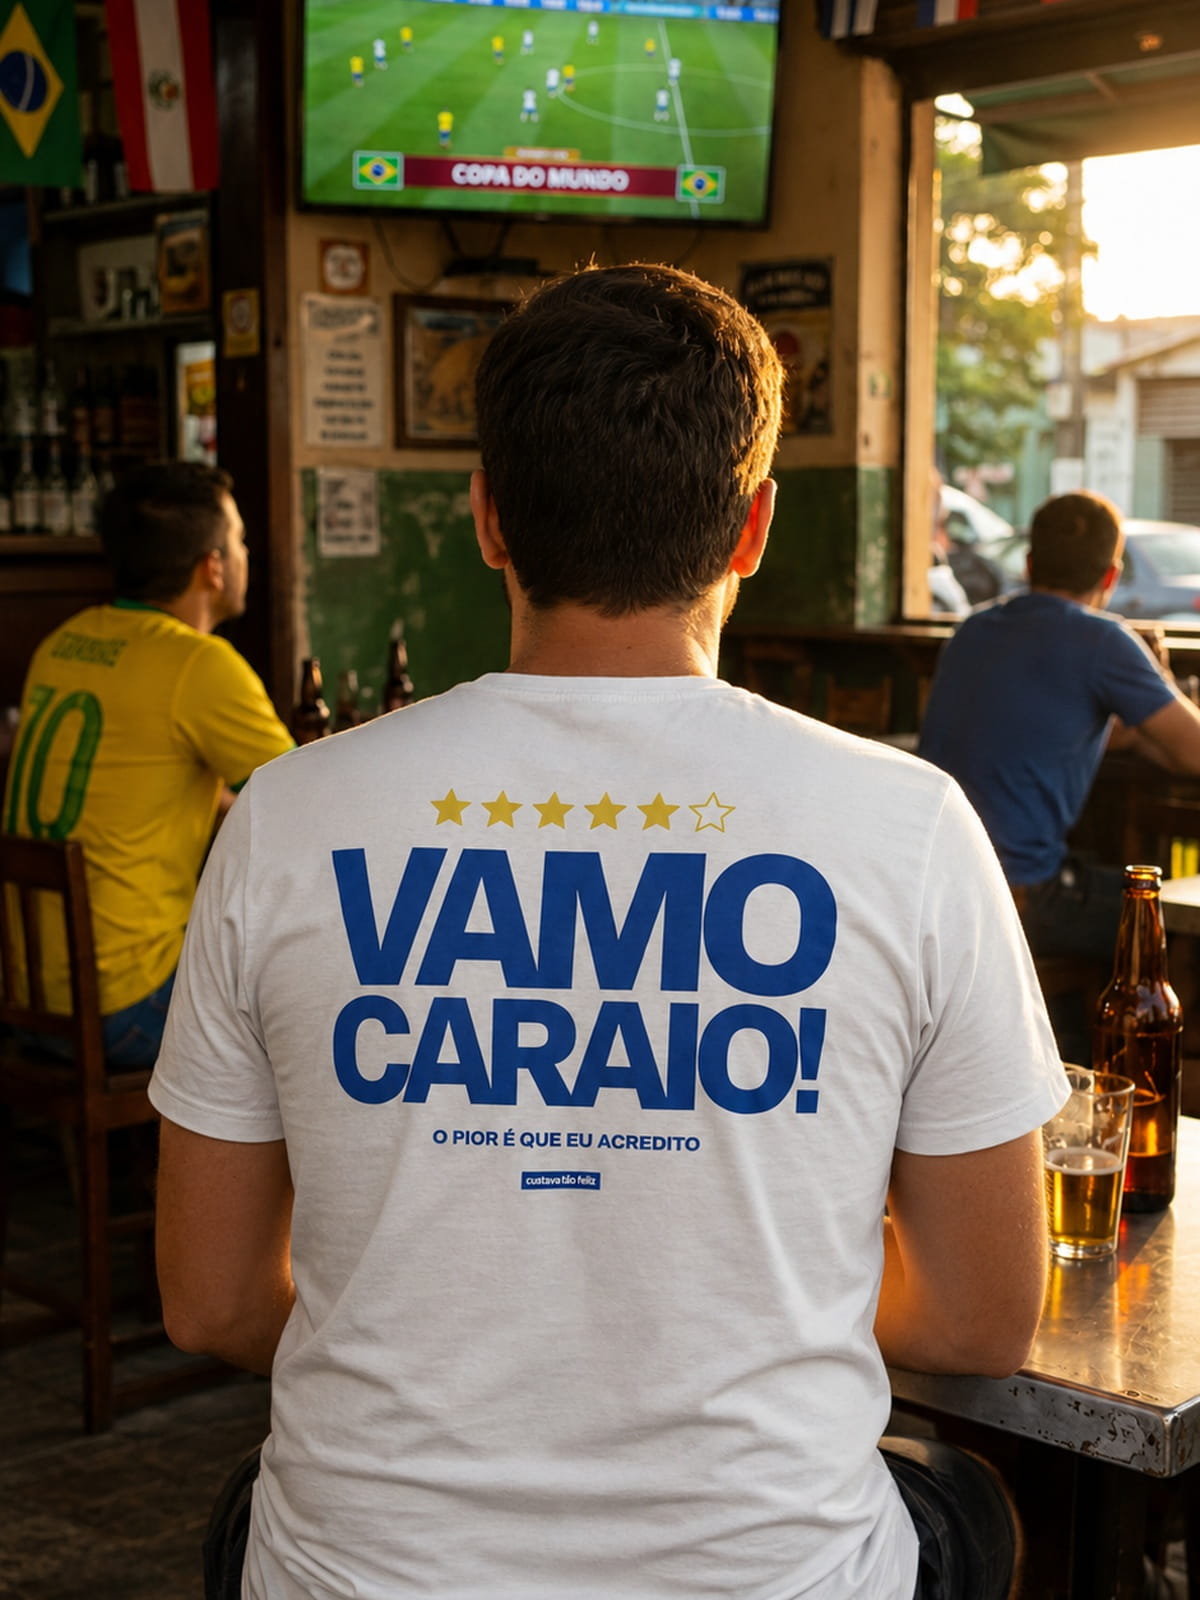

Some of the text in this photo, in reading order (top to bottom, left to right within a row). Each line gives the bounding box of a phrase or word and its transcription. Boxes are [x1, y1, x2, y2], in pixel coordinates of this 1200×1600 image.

[451, 163, 630, 191] COPA DO MUNDO
[7, 684, 103, 841] 10
[332, 847, 837, 997] VAMO
[333, 995, 827, 1114] CARAIO!
[432, 1128, 701, 1151] O PIOR É QUE EU ACREDITO
